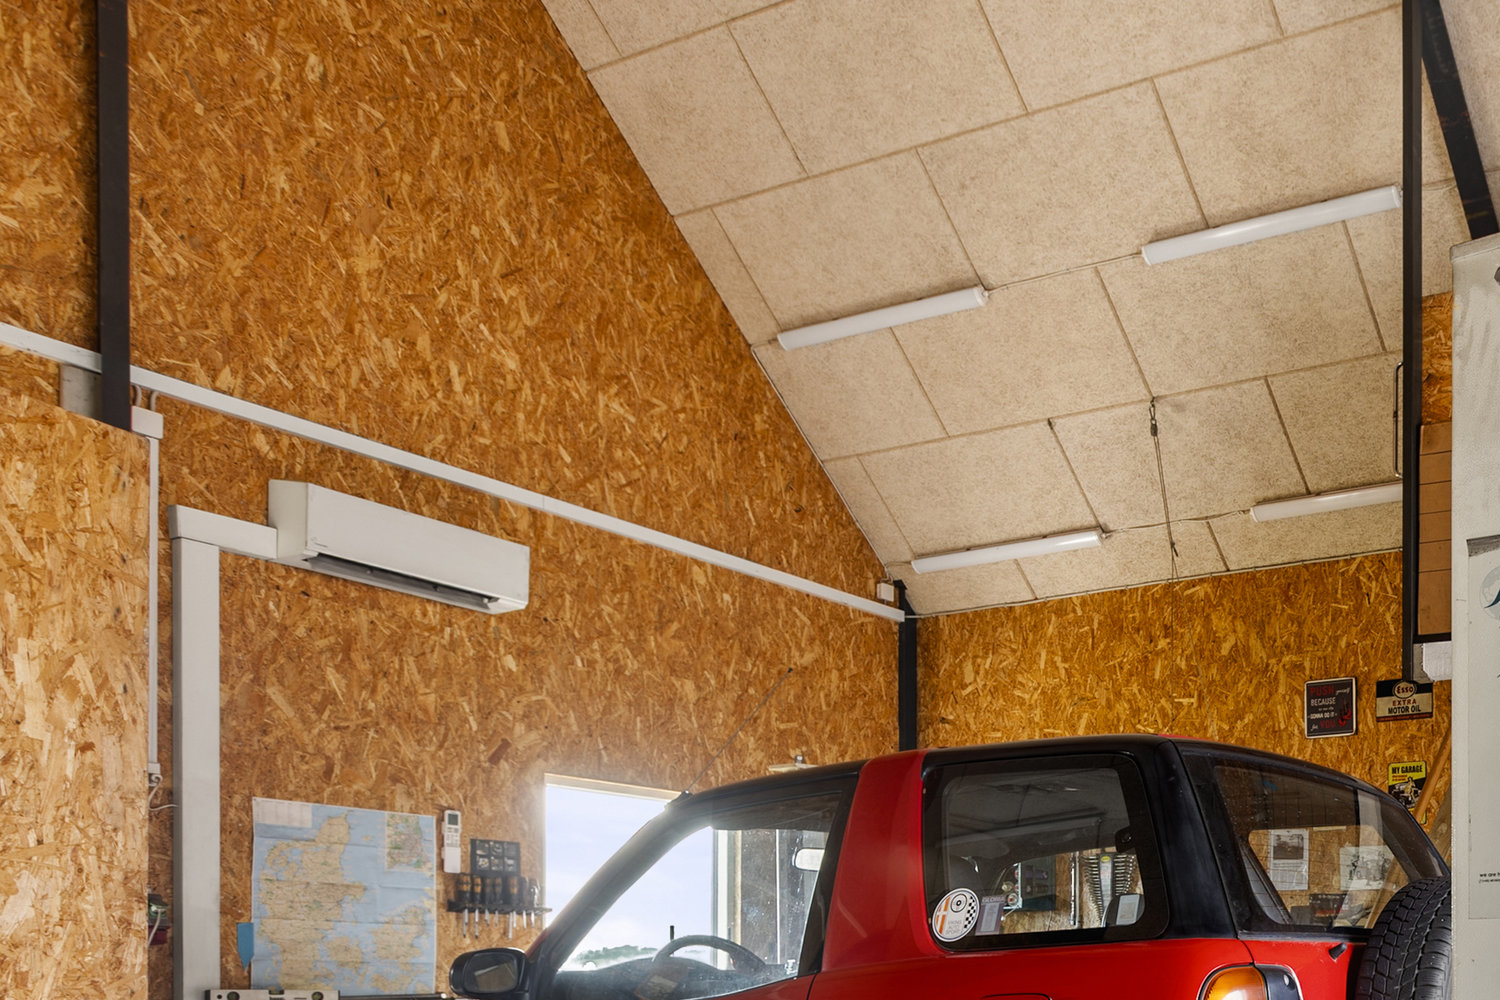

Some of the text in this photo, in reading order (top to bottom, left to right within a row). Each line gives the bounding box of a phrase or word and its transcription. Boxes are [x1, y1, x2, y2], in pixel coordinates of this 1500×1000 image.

[1310, 685, 1335, 697] PUSH
[1396, 685, 1414, 694] Esso
[1311, 697, 1336, 706] BECAUSE
[1388, 704, 1421, 714] MOTOR OIL
[1392, 764, 1423, 774] MY GARAGE
